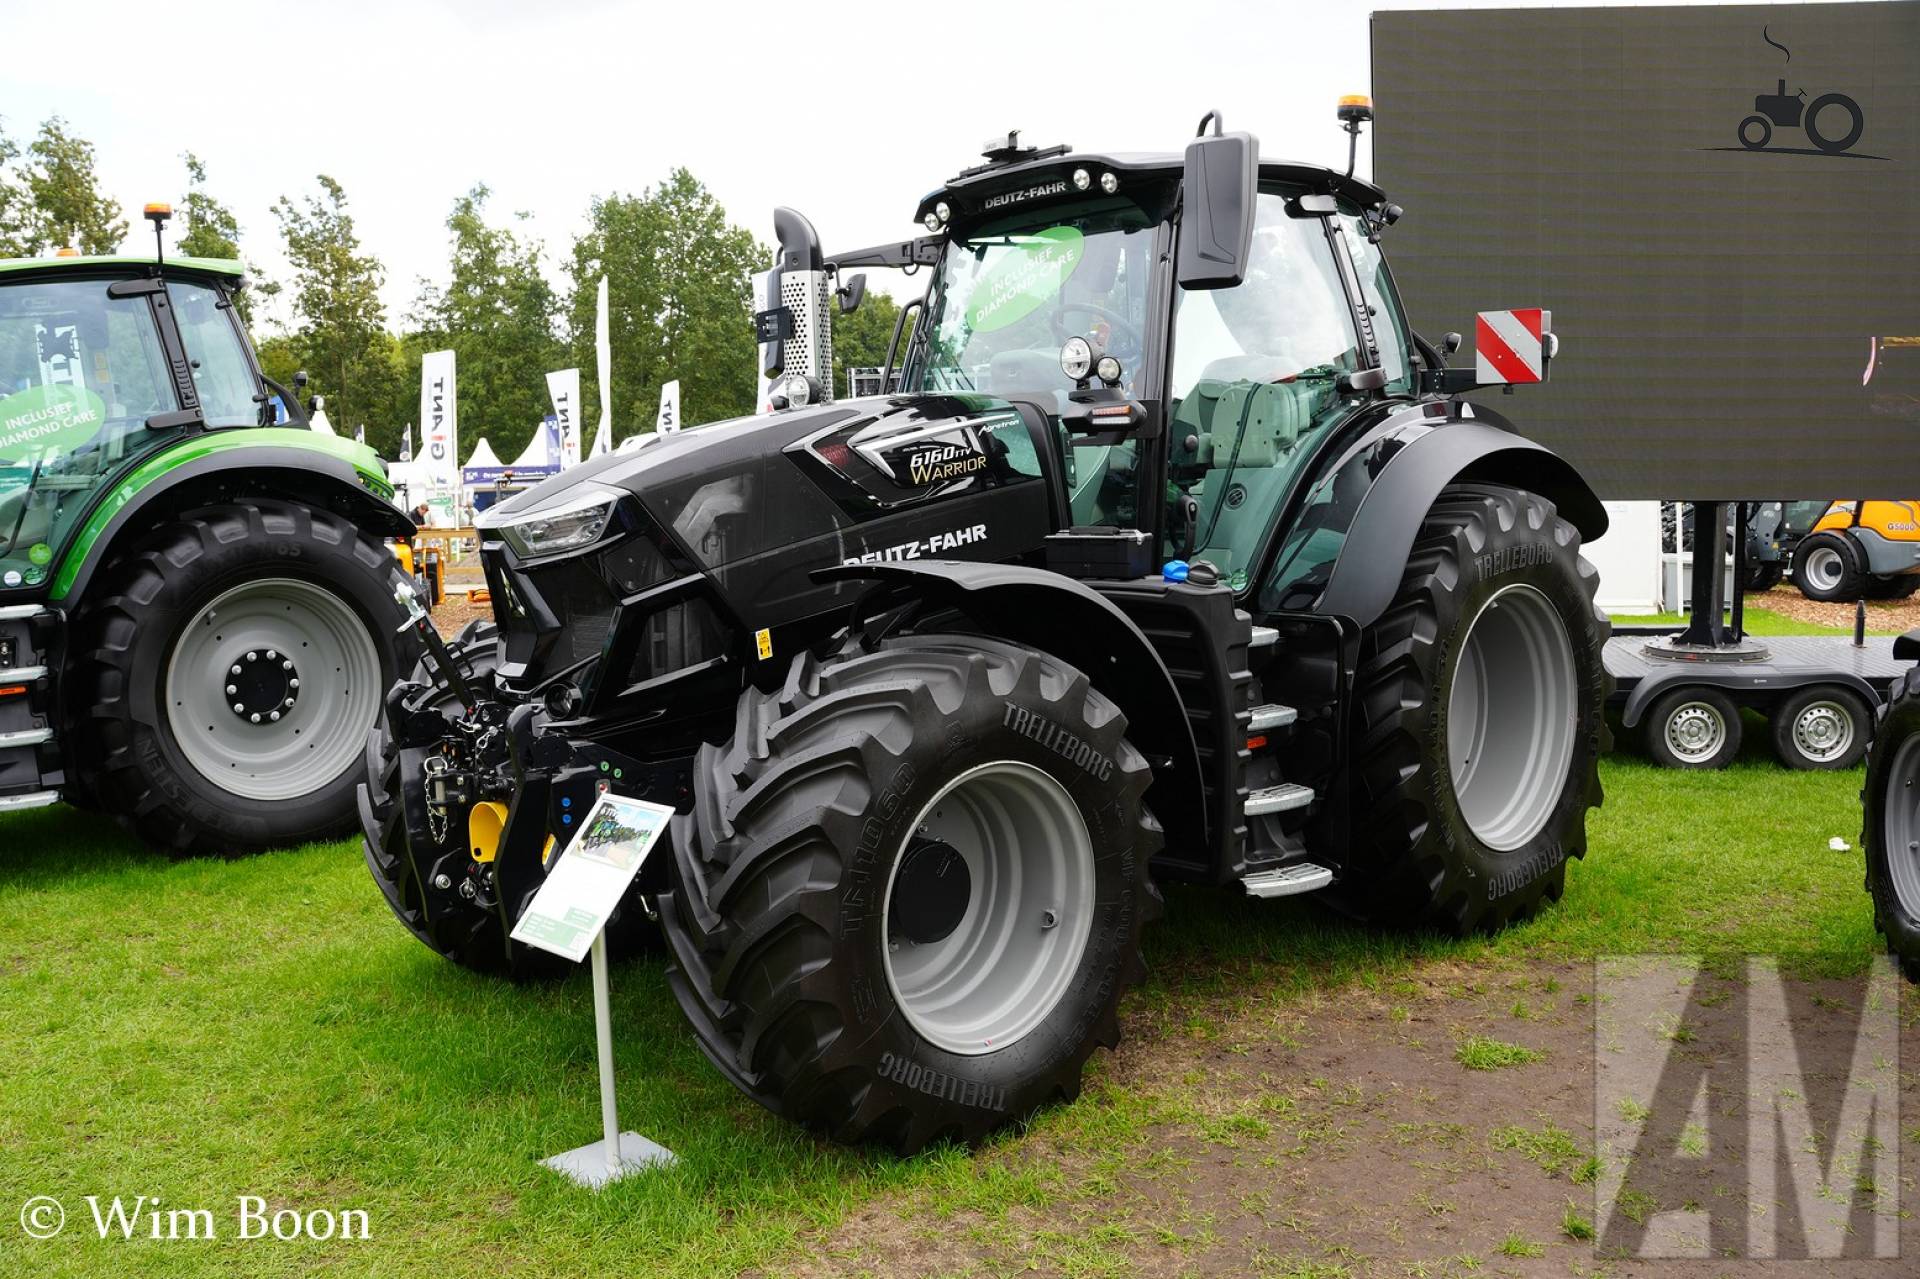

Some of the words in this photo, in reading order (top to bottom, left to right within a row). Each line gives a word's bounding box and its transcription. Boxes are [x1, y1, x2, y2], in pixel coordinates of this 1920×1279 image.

[985, 181, 1067, 209] DEUTZ-FAHR
[5, 401, 73, 430] INCLUSIEF
[63, 409, 97, 428] CARE
[1473, 541, 1554, 582] TRELLEBORG
[1003, 700, 1115, 784] TRELLEBORG
[1488, 839, 1565, 903] TRELLEBORG
[877, 1051, 1007, 1112] TRELLEBORG
